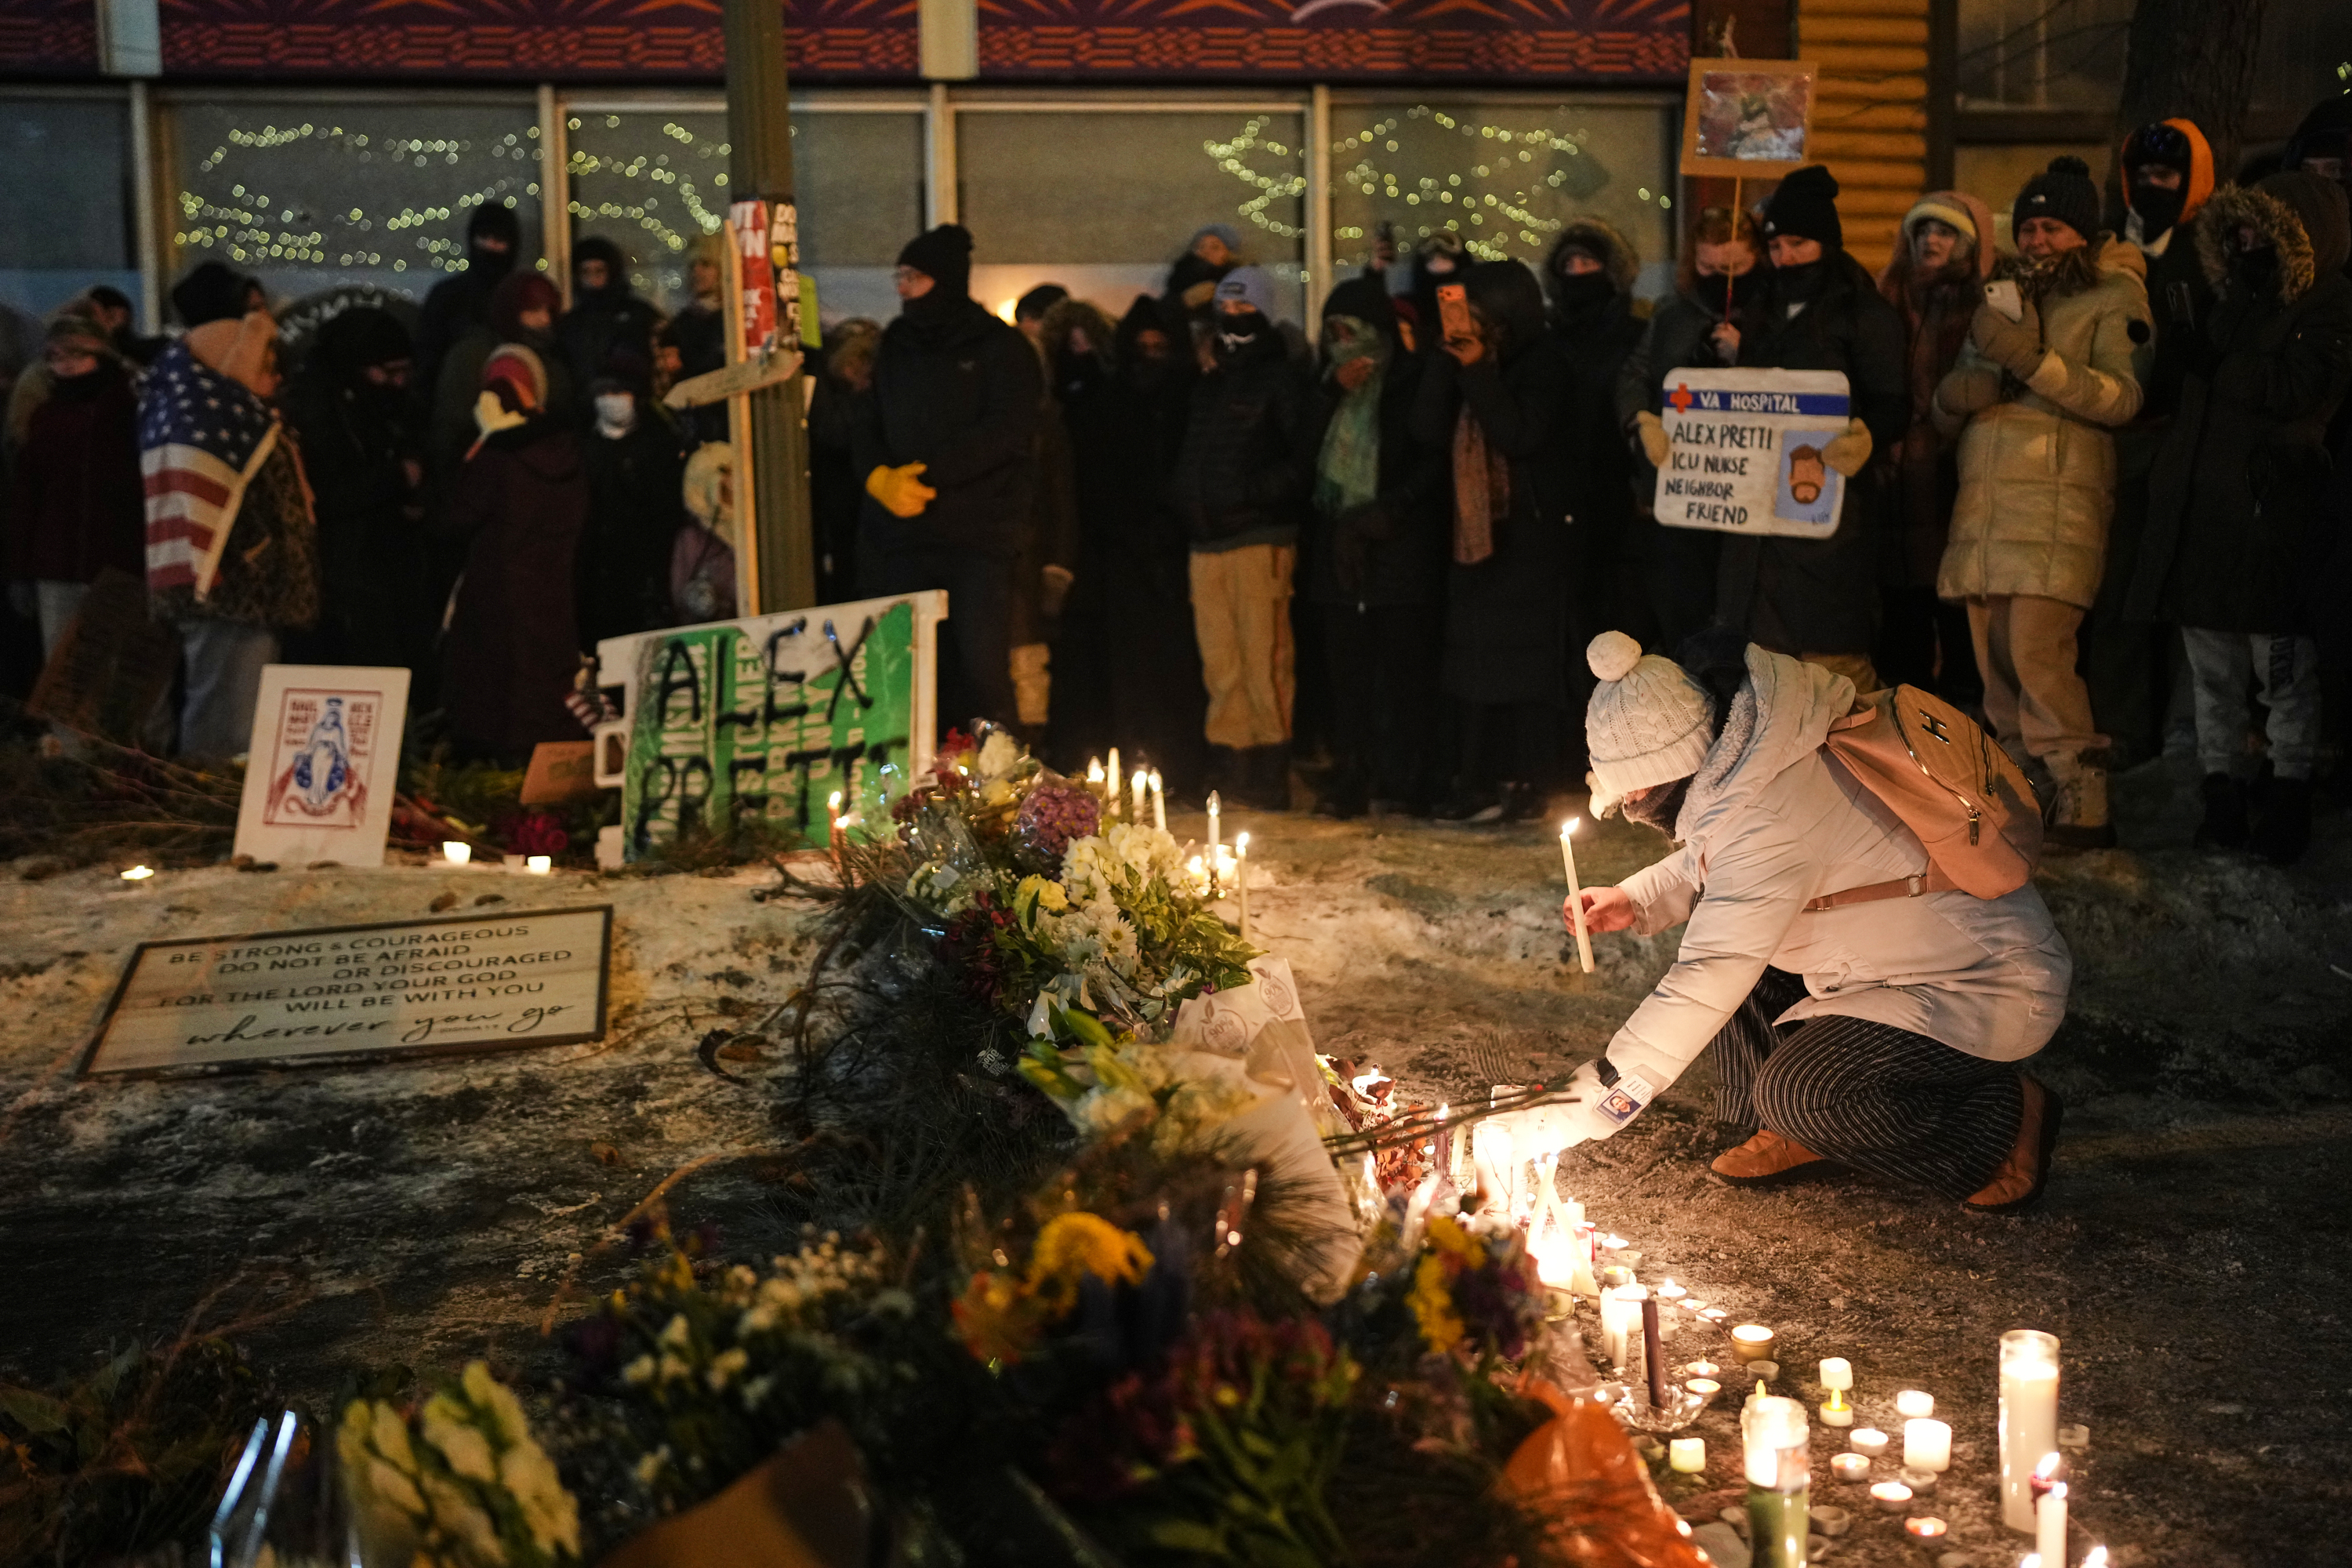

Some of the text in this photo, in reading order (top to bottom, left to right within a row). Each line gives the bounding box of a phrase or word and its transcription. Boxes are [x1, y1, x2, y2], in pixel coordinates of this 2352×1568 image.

[1700, 391, 1800, 413] VA HOSPITAL
[1672, 421, 1773, 450] ALEX PRETTI
[1672, 452, 1748, 476] ICU NURSE
[1665, 478, 1733, 499] NEIGHBOR
[1686, 502, 1748, 524] FRIEND
[657, 616, 874, 730] ALEX
[169, 926, 530, 964] BE STRONG & COURAGEOUS
[219, 945, 470, 975] DO NOT BE AFRAID
[332, 949, 572, 981] OR DISCOURAGED
[160, 969, 517, 1008] FOR THE LORD YOUR GOD
[285, 982, 545, 1013] WILL BE WITH YOU
[187, 1004, 575, 1046] wherever you go
[1208, 1016, 1234, 1038] 90%
